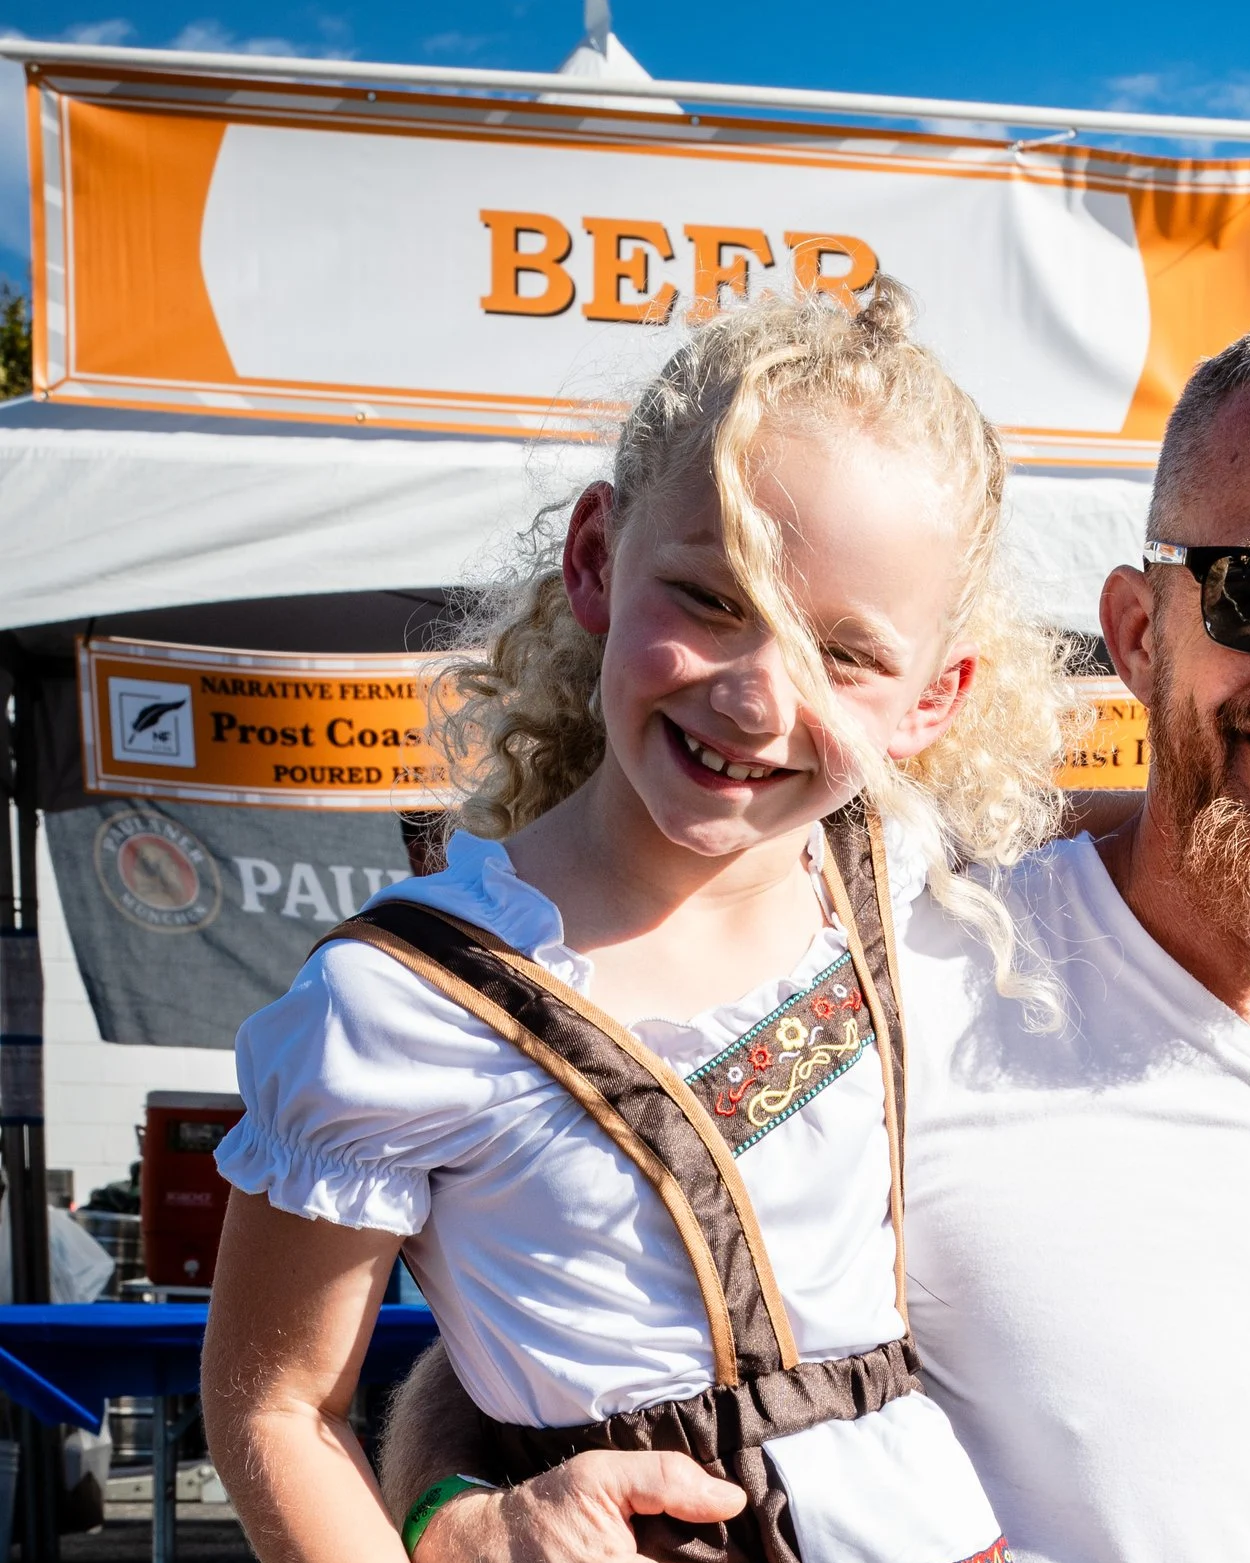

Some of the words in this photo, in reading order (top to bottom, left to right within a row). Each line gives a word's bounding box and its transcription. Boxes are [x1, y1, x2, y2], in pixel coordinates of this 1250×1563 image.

[479, 208, 880, 326] BEER
[200, 676, 334, 700] NARRATIVE
[209, 711, 316, 747] Prost
[326, 717, 422, 748] Coas
[272, 764, 382, 785] POURED
